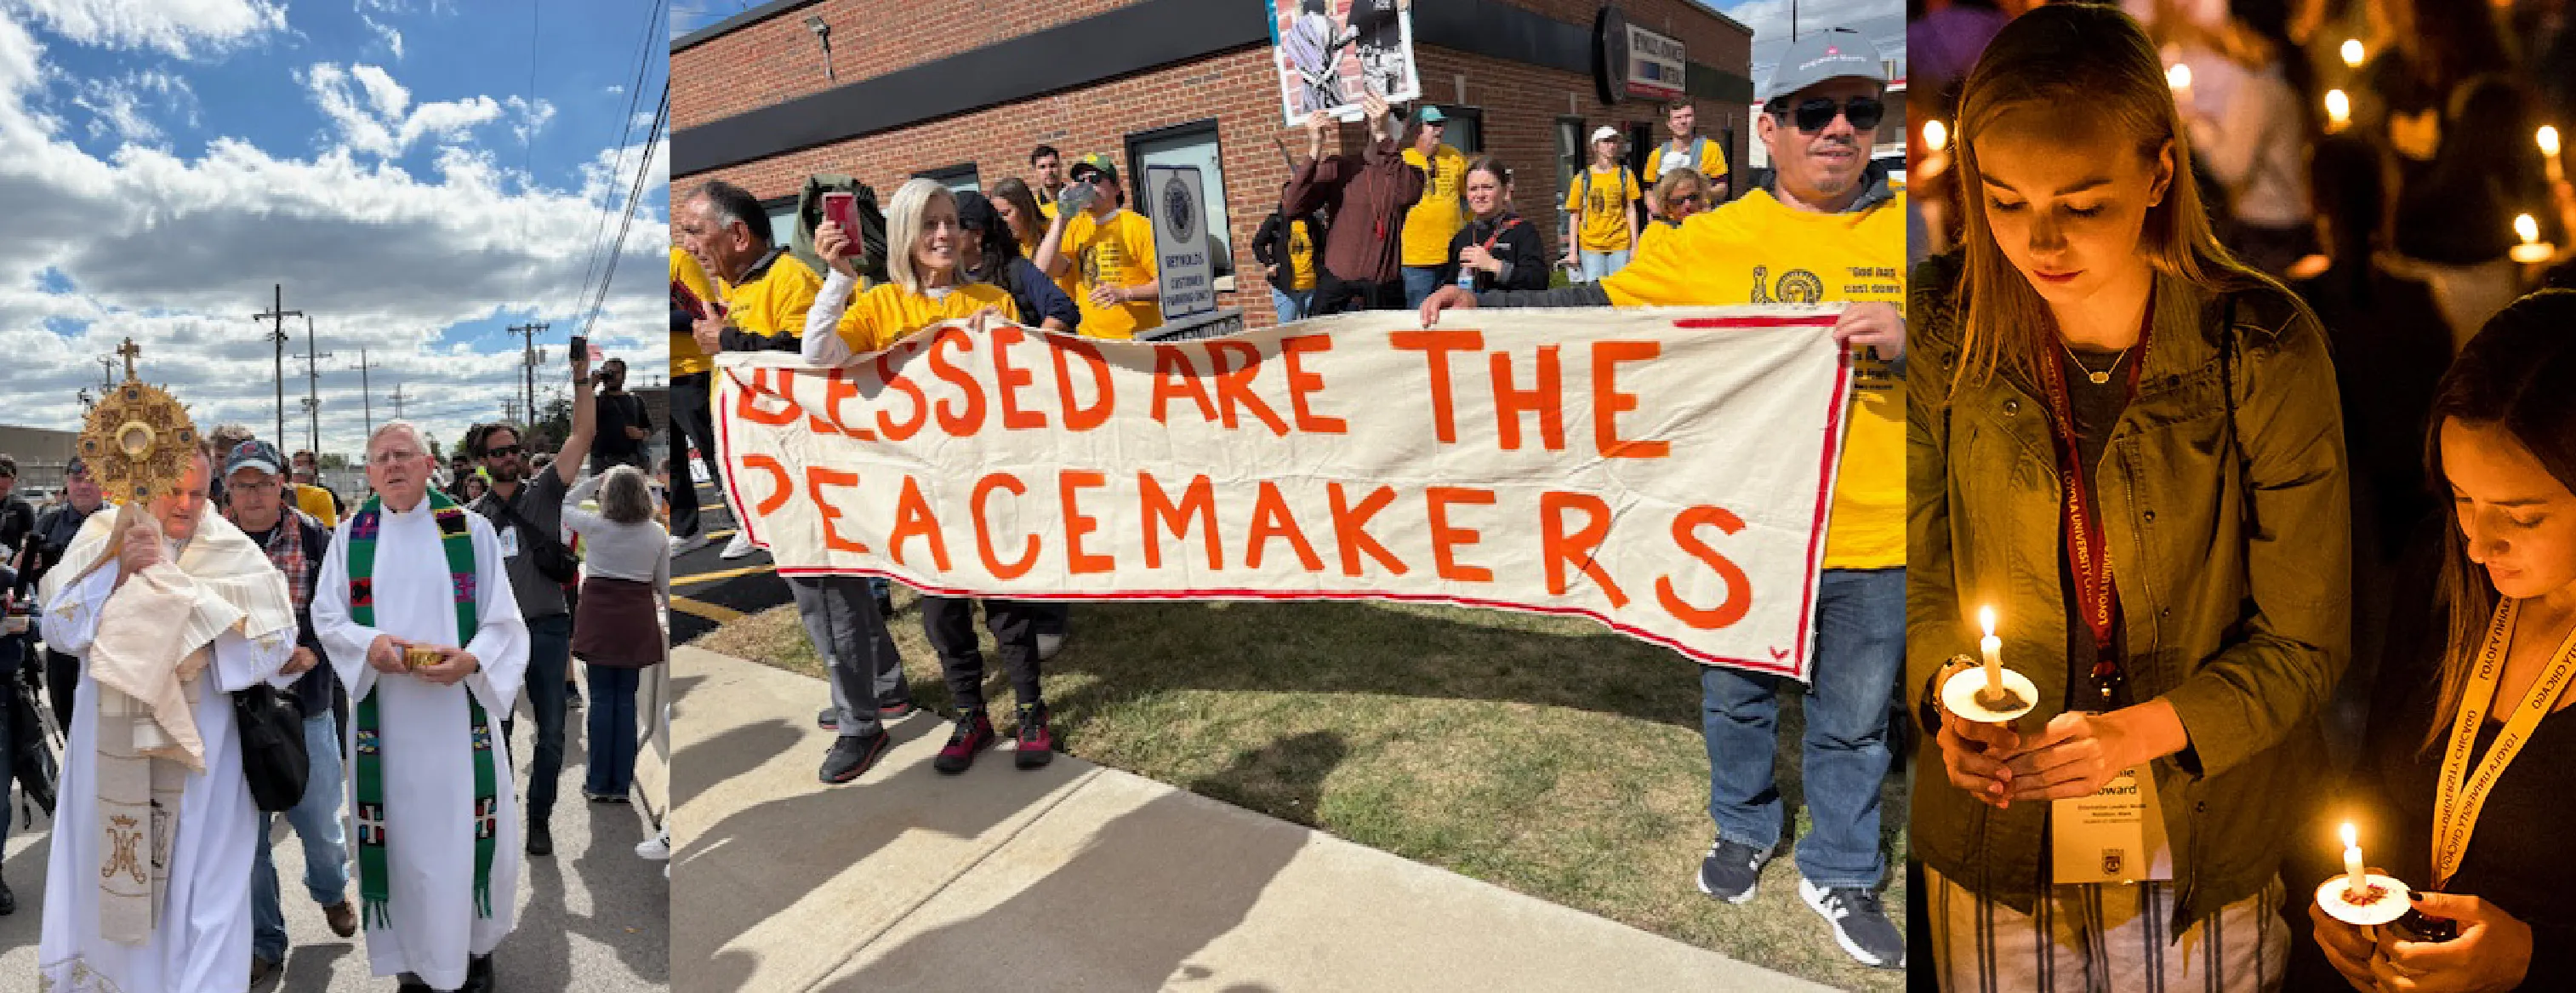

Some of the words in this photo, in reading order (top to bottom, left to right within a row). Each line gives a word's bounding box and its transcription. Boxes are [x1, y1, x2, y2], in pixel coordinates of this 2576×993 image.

[1153, 335, 1347, 437] ARE
[1391, 331, 1669, 459] THE
[743, 455, 1752, 630] PEACEMAKERS
[2071, 514, 2093, 577] UNIVERSITY
[2098, 785, 2137, 795] oward
